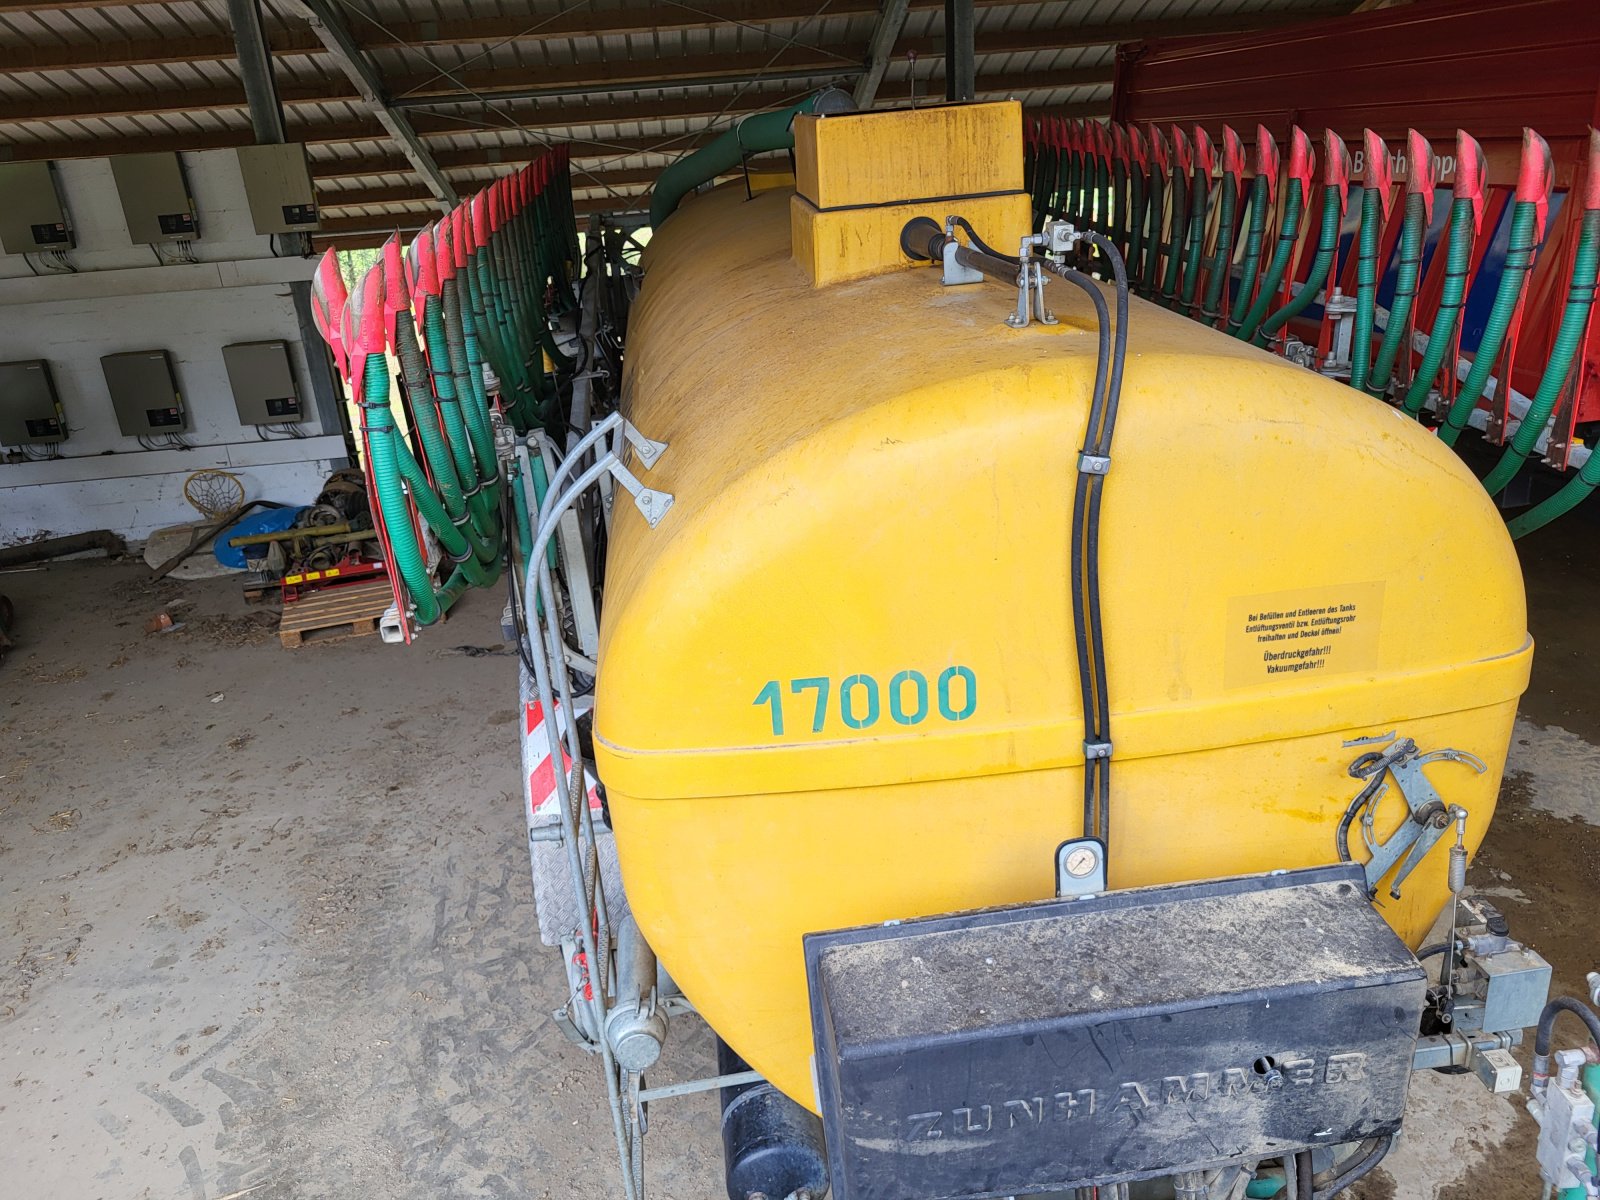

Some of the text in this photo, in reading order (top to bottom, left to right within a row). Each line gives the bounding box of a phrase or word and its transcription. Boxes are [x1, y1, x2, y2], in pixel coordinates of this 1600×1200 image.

[1248, 603, 1356, 622] Bei Befüllen und Entleeren des Tanks
[1246, 615, 1356, 633] Entlüftungsventil bzw. Entlüftungsrohr
[1257, 626, 1342, 643] freihalten und Deckel öffnen!
[1264, 645, 1332, 662] Überdruckgefahr!!!
[1267, 659, 1325, 674] Vakuumgefahr!!!
[752, 665, 977, 736] 17000
